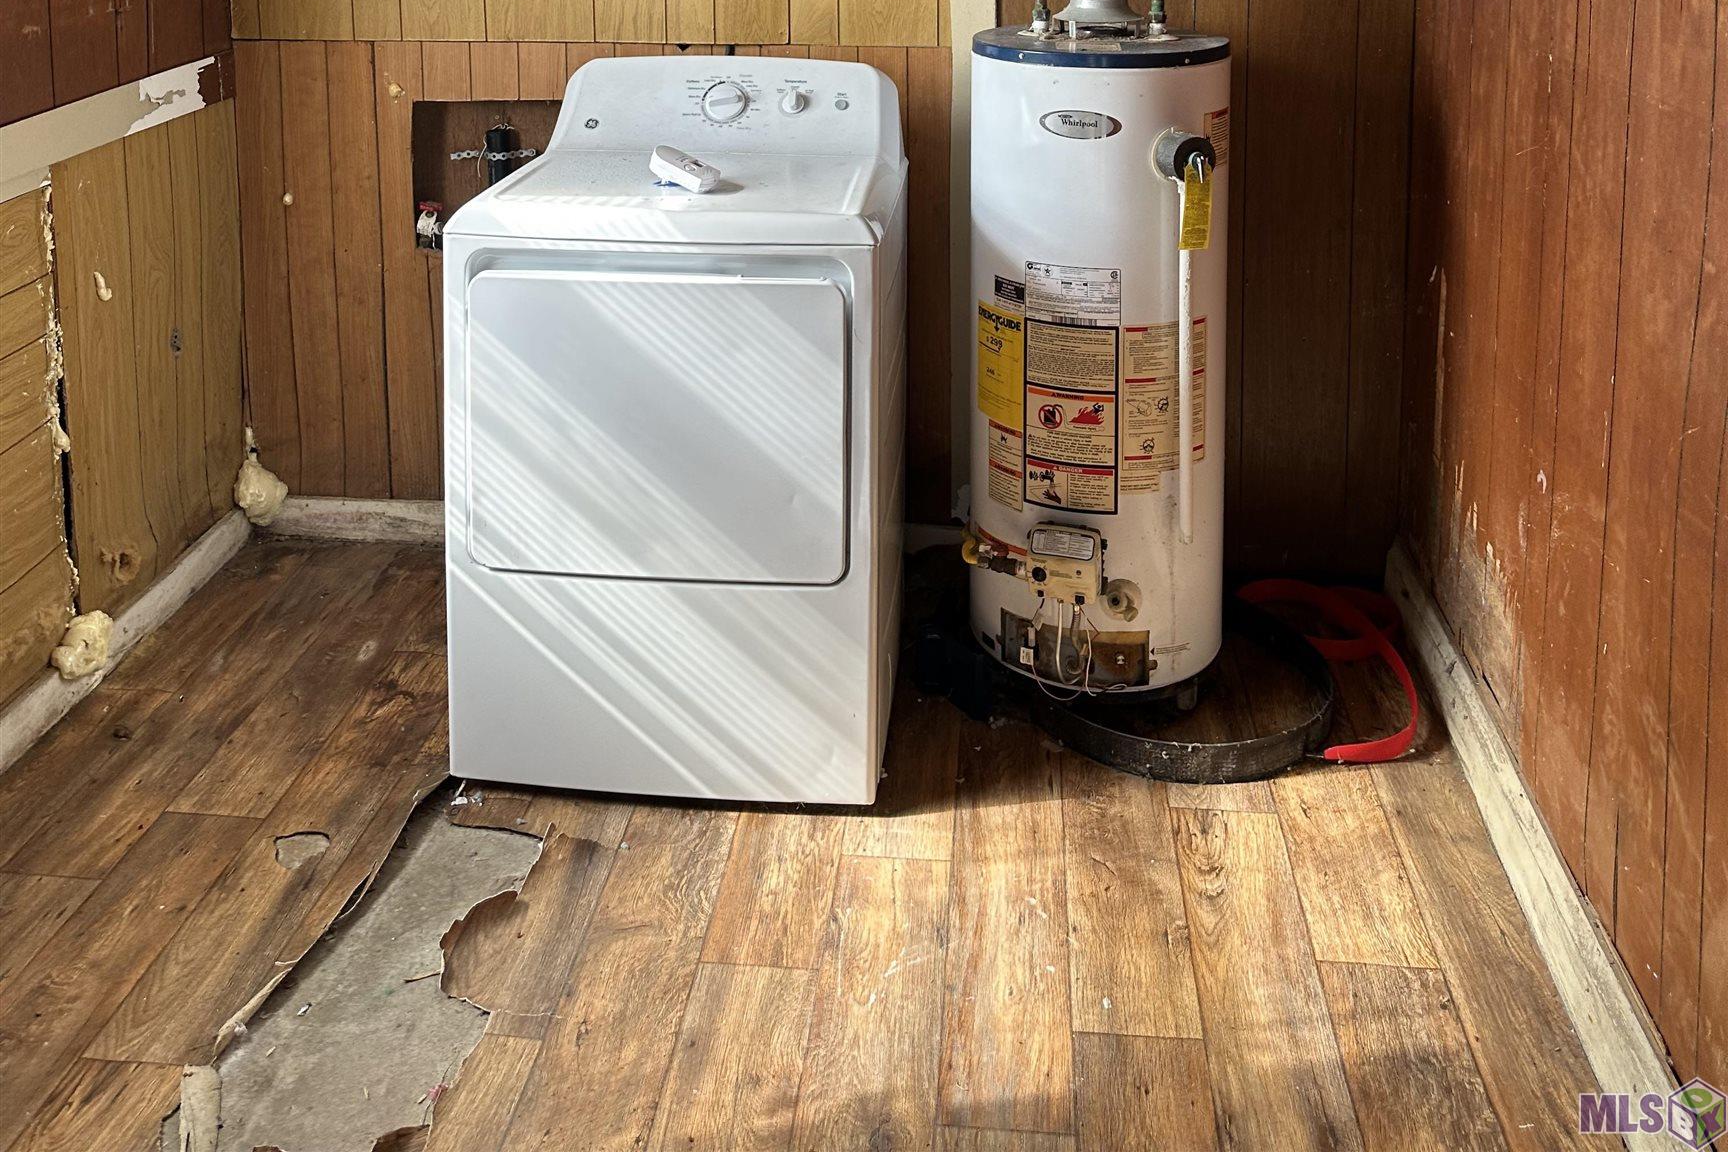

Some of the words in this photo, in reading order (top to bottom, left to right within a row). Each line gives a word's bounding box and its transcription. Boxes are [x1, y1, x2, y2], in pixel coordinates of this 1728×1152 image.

[1061, 118, 1098, 129] Whirlpool
[1056, 392, 1085, 401] WARNING
[1058, 466, 1083, 474] DANGER
